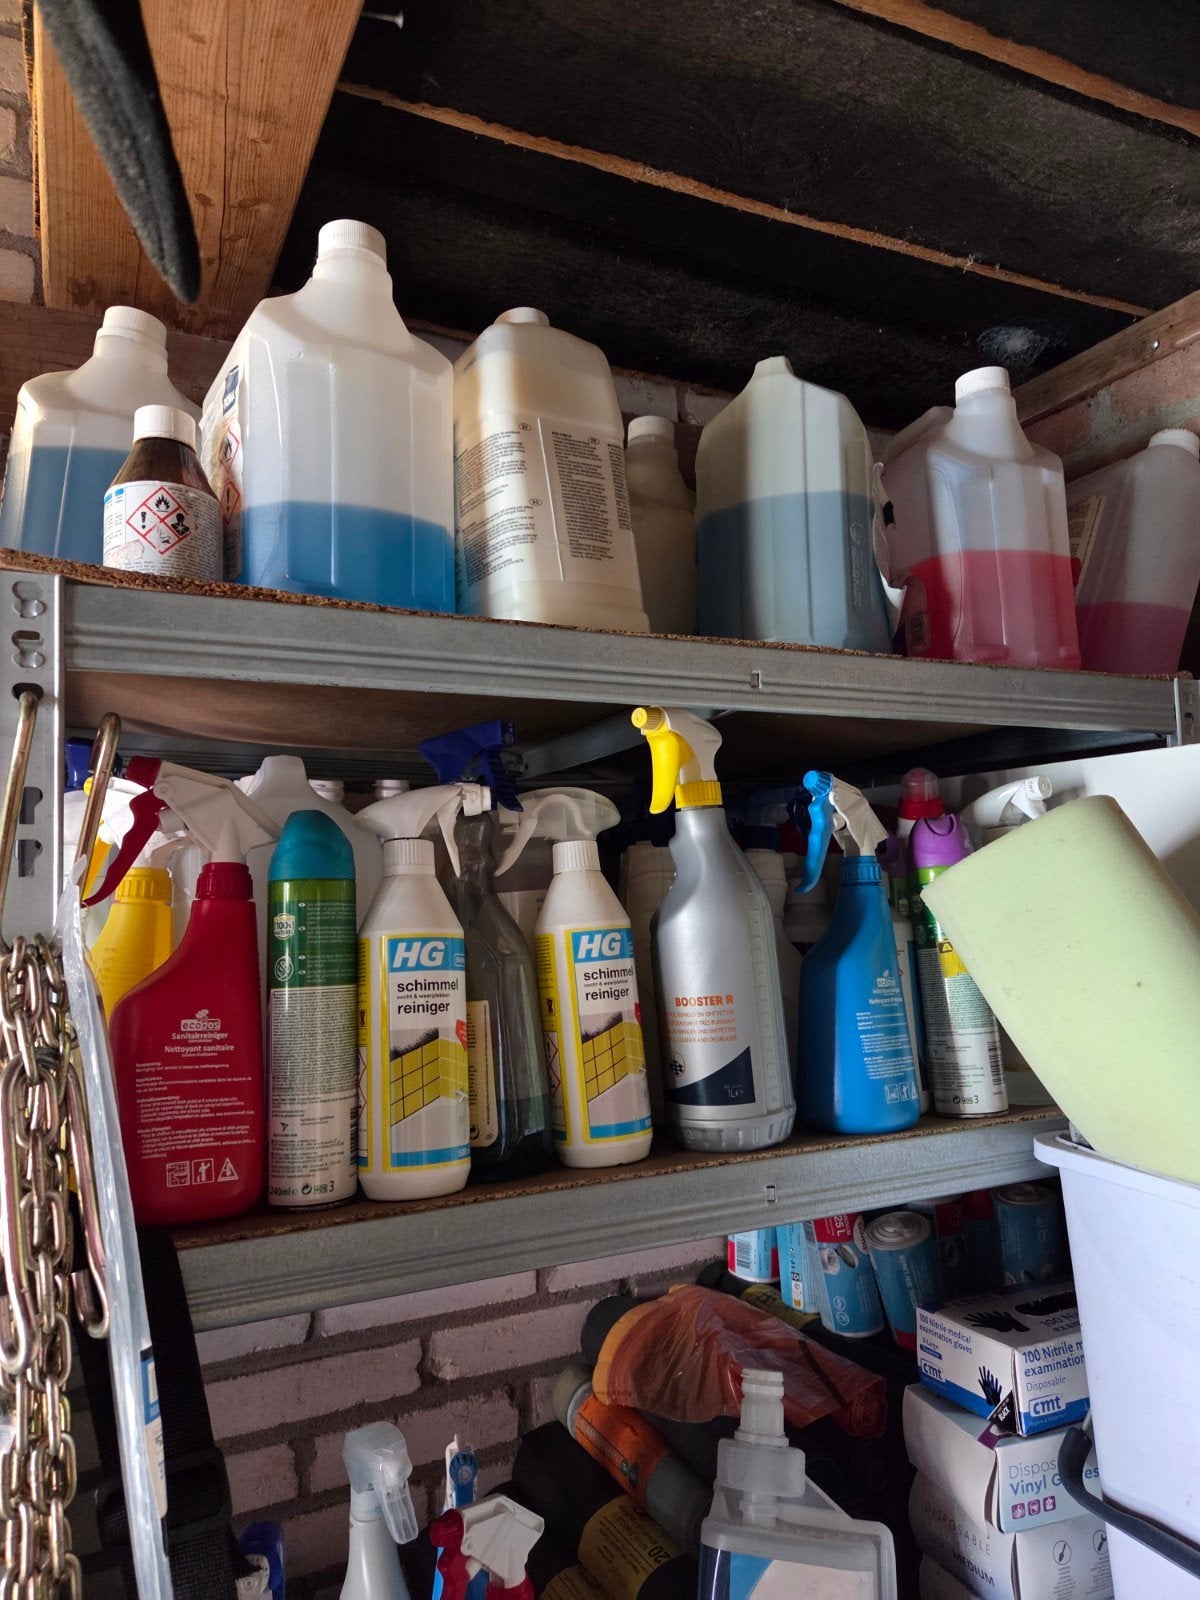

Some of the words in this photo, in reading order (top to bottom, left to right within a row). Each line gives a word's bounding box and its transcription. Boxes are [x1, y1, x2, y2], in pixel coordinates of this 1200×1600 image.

[578, 932, 622, 959] HG
[392, 940, 446, 968] HG
[584, 966, 634, 981] schimmel
[397, 978, 458, 992] schimmel
[586, 988, 630, 1000] reiniger
[675, 996, 723, 1007] BOOSTER
[726, 994, 733, 1004] R
[398, 1000, 450, 1016] reiniger
[182, 1020, 220, 1030] ecodos
[172, 1032, 228, 1040] Sanitairreiniger
[164, 1045, 201, 1054] Nettoyant
[203, 1044, 234, 1052] sanitaire
[974, 1095, 979, 1104] 3
[329, 1180, 335, 1192] 3
[834, 1214, 844, 1228] 25
[920, 1314, 928, 1324] 100
[930, 1318, 946, 1332] Nitrile
[948, 1328, 971, 1343] medical
[920, 1324, 952, 1346] examination
[954, 1340, 972, 1354] gloves
[1022, 1349, 1040, 1364] 100
[1042, 1342, 1074, 1360] Nitrile
[923, 1362, 943, 1380] cmt
[1026, 1376, 1066, 1392] Disposable
[1032, 1395, 1062, 1415] cmt
[998, 1407, 1011, 1422] BLACK
[1009, 1460, 1056, 1479] Dispos
[1010, 1475, 1046, 1496] Vinyl
[926, 1502, 990, 1556] DISPOSABLE
[952, 1549, 995, 1588] MEDIUM
